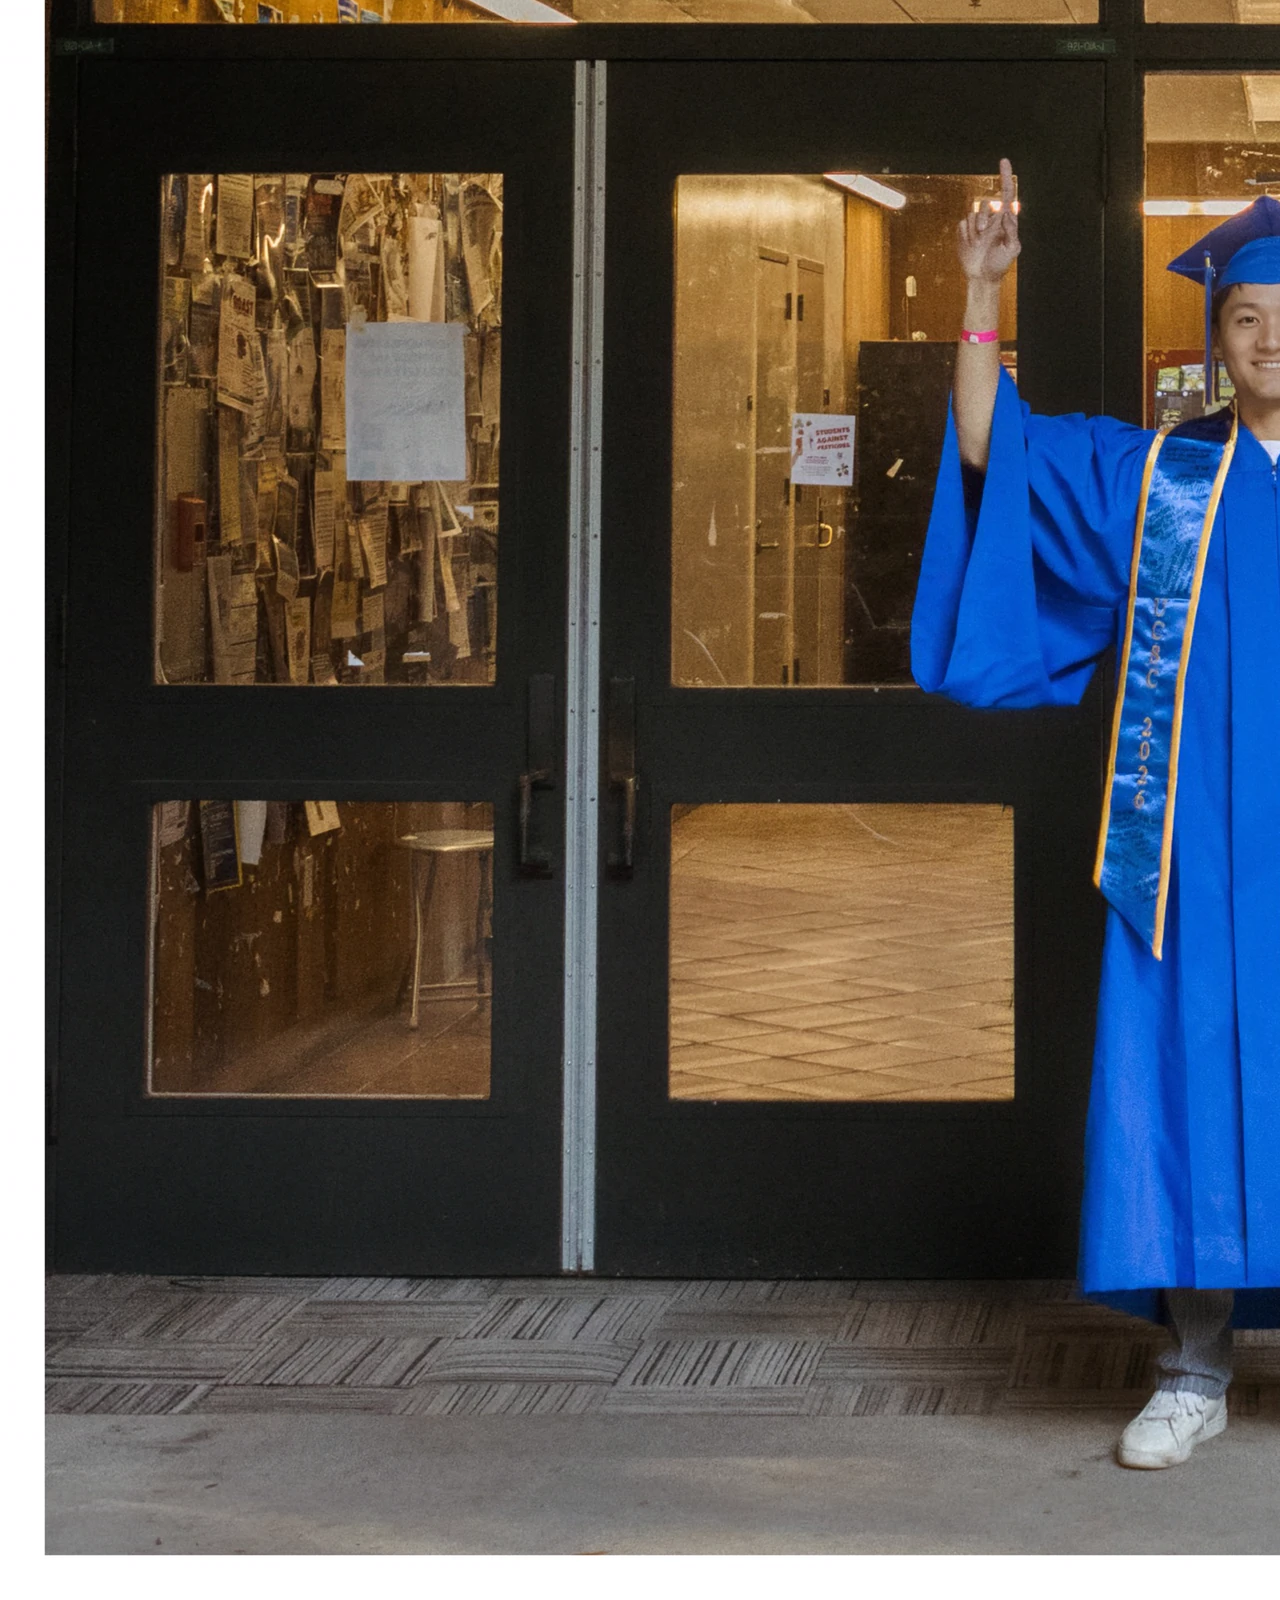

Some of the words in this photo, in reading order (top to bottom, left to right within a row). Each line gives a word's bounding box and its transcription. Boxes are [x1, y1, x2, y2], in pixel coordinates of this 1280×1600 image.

[815, 426, 851, 436] STUDENTS
[816, 434, 849, 444] AGAINST
[1145, 597, 1169, 689] UCSC
[1133, 716, 1153, 810] 2026
